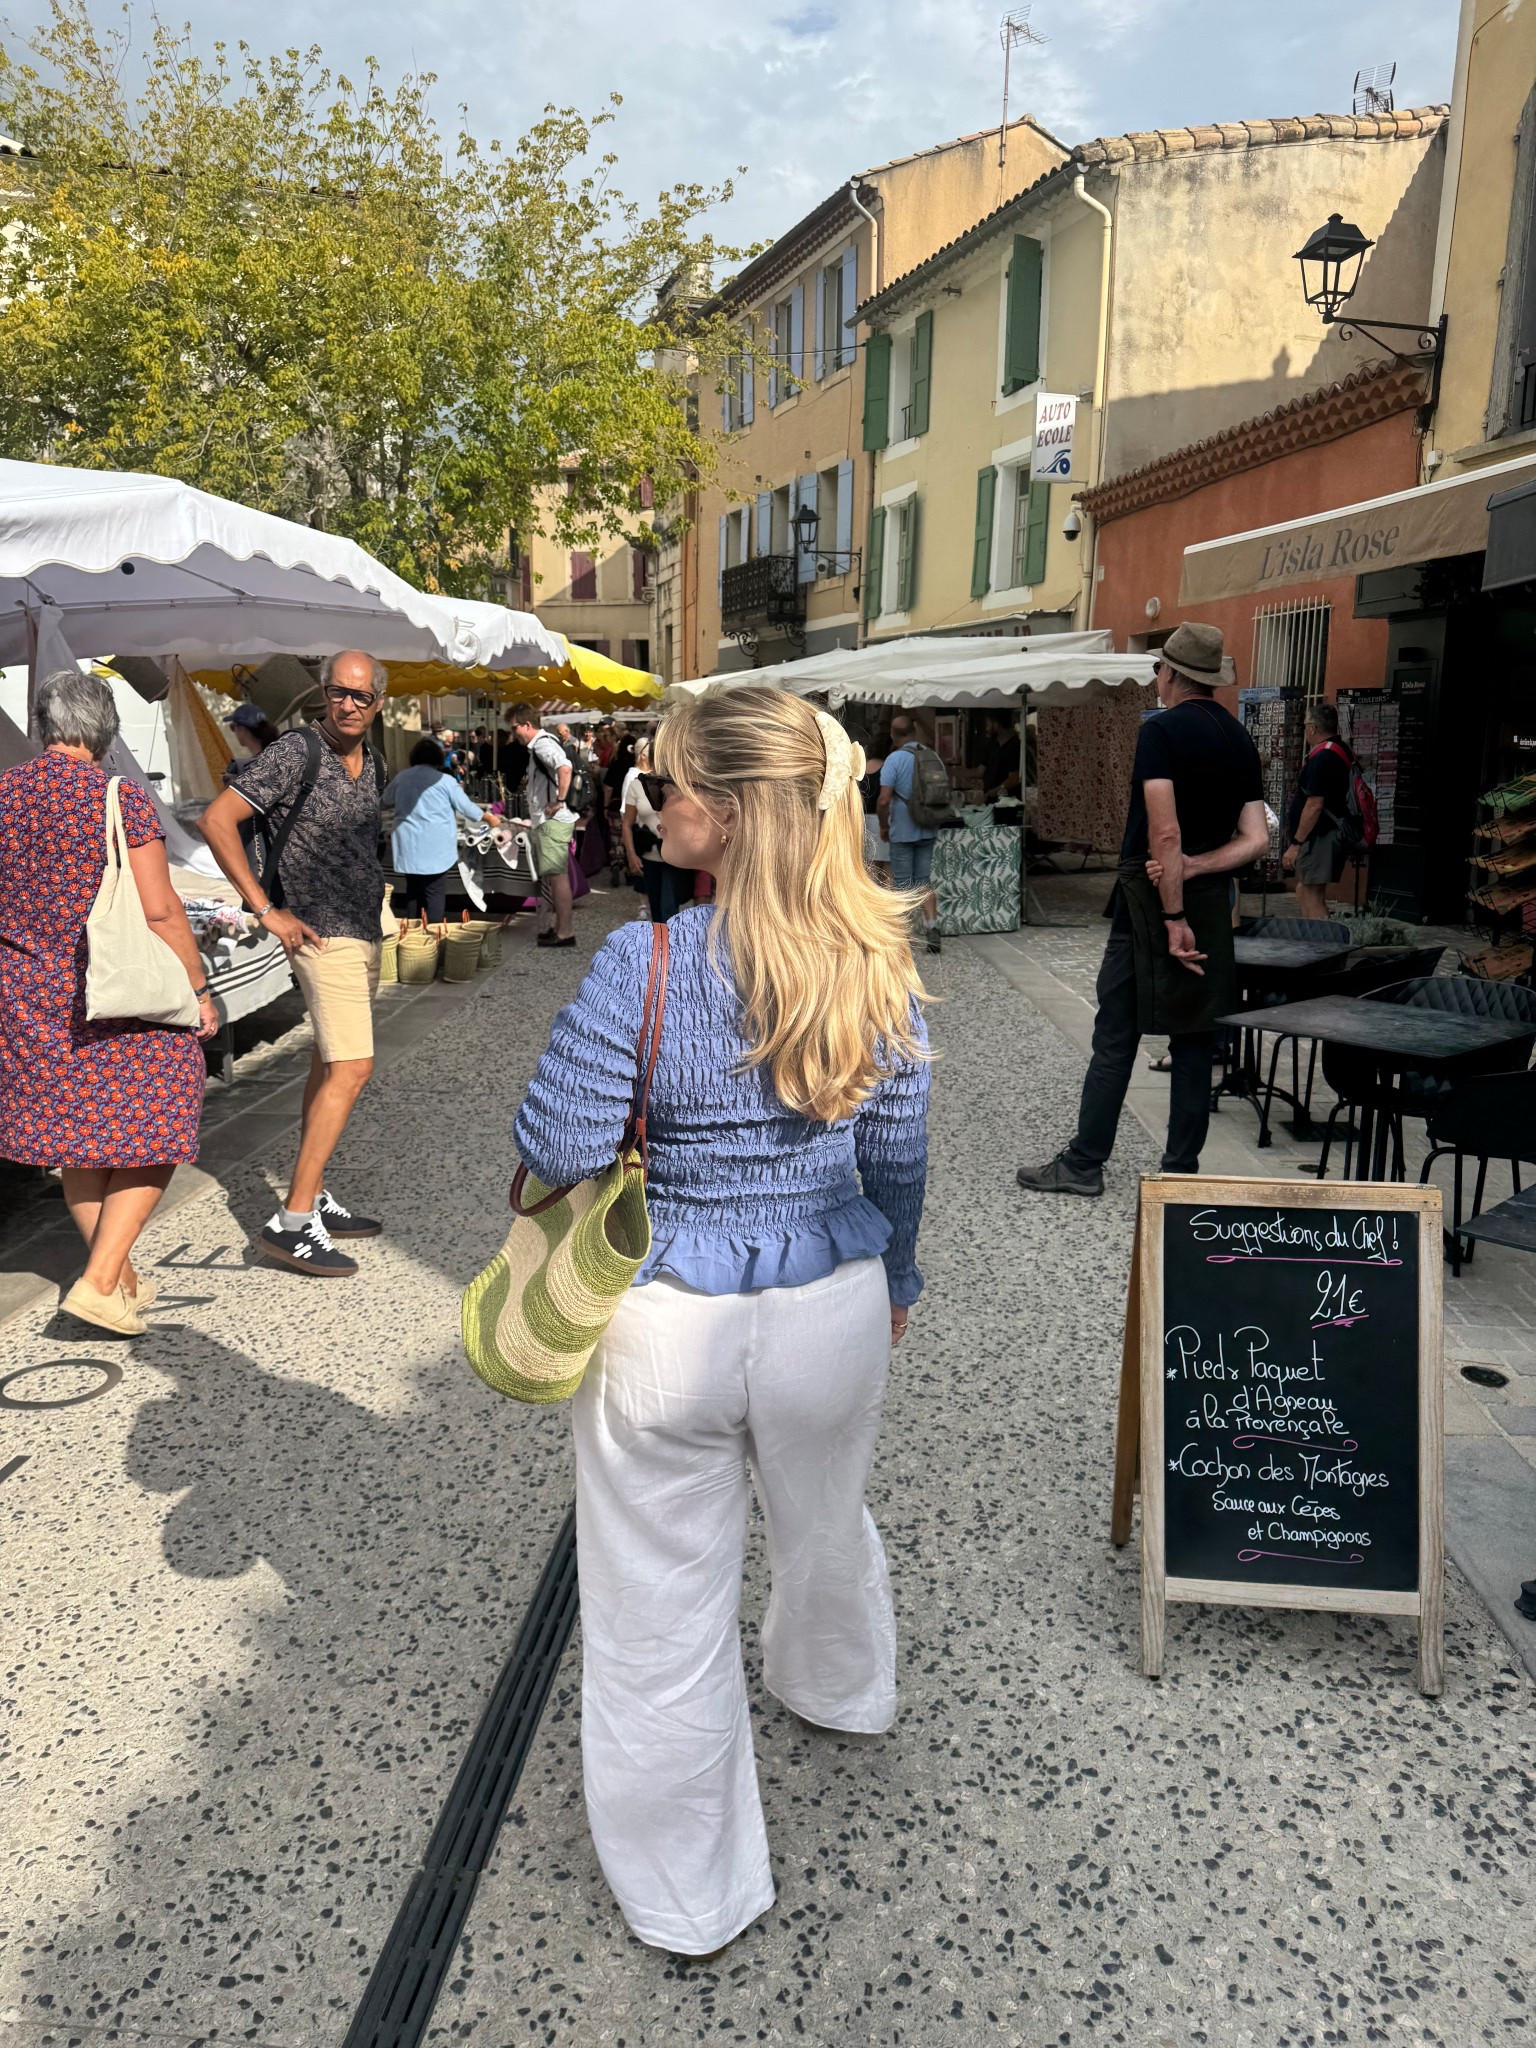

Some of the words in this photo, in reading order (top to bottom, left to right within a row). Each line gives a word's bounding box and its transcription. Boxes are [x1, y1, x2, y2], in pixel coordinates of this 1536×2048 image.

[1039, 402, 1071, 424] AUTO
[1036, 424, 1073, 448] ECOLE
[1328, 526, 1401, 567] Rose
[1189, 1209, 1322, 1255] Suggestions
[1324, 1215, 1349, 1249] du
[1352, 1216, 1390, 1264] Chef
[1309, 1270, 1366, 1321] 21€
[1233, 1325, 1326, 1396] Paquet
[1203, 1393, 1229, 1429] la
[1225, 1408, 1350, 1440] Provençale
[1232, 1384, 1338, 1418] d'Agneau
[1179, 1443, 1251, 1488] Cochon
[1257, 1453, 1295, 1482] des
[1298, 1453, 1390, 1497] Montagnes
[1211, 1491, 1255, 1512] Sauce
[1257, 1500, 1286, 1515] aux
[1246, 1520, 1264, 1541] et
[1267, 1521, 1372, 1550] Champignons
